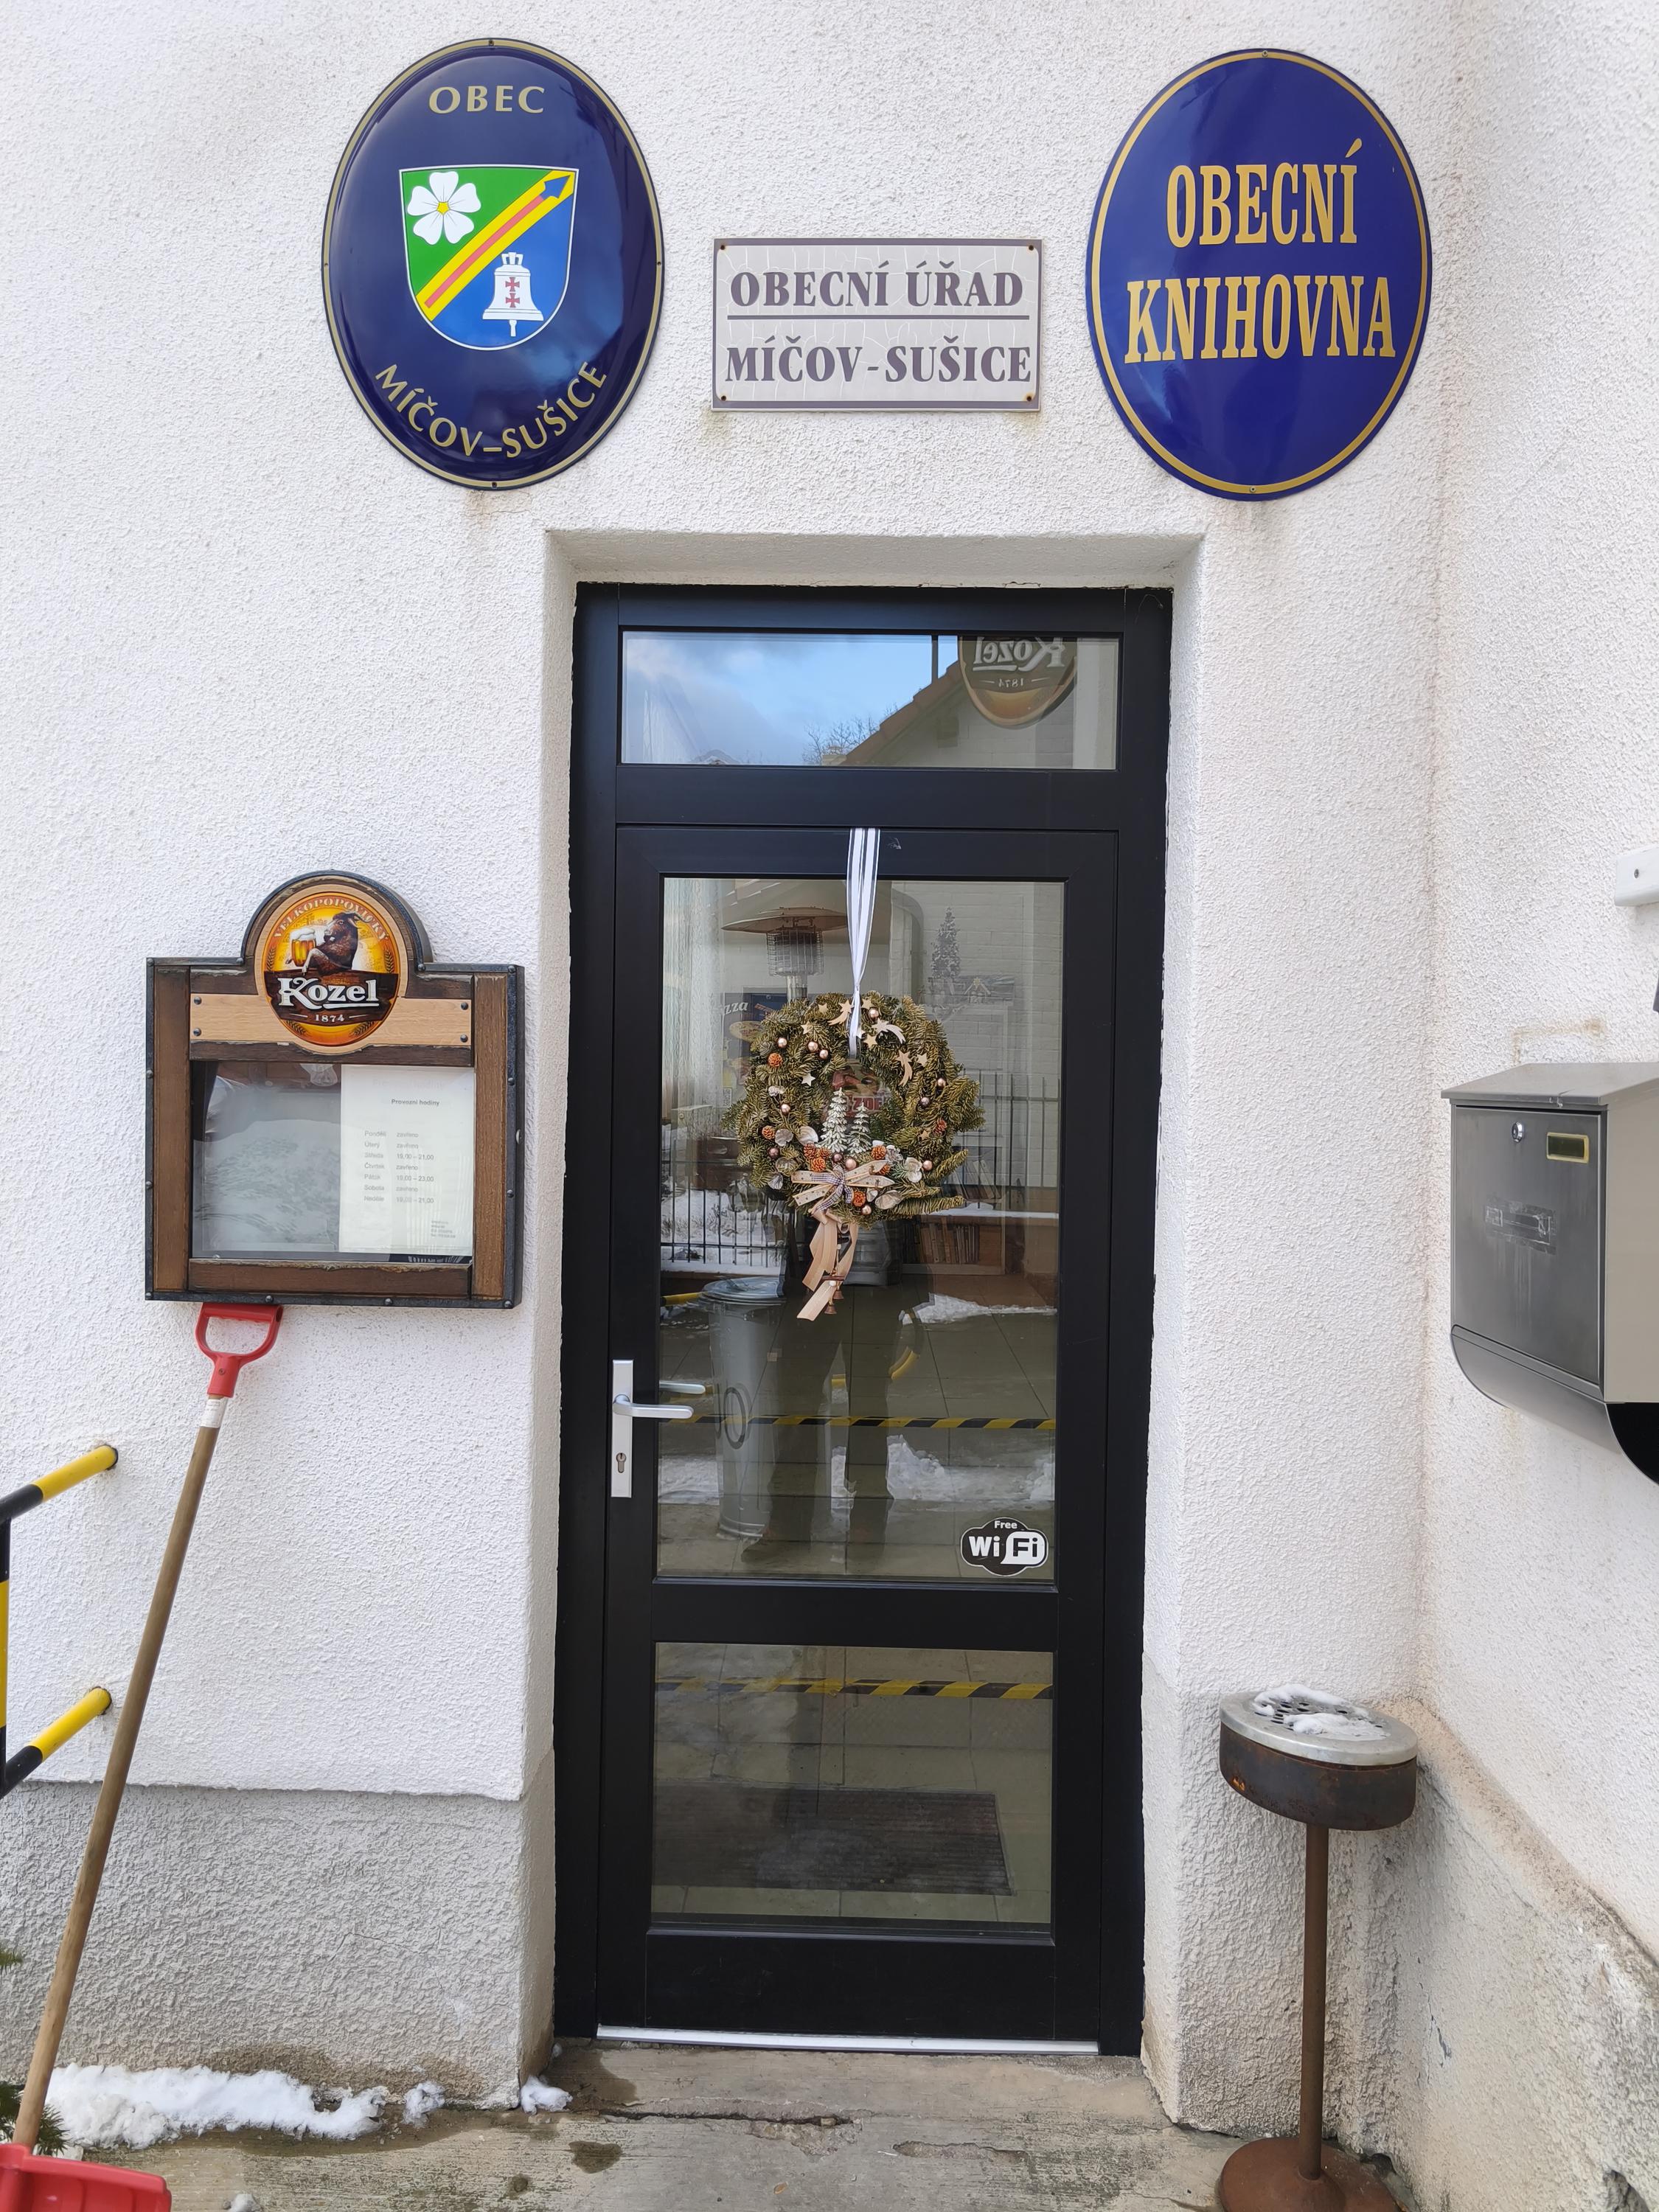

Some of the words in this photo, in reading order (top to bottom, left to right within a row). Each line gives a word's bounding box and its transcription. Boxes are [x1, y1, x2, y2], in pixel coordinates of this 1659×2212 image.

[428, 84, 546, 115] OBEC
[1166, 137, 1363, 248] OBECNÍ
[730, 260, 889, 307] OBECNÍ
[905, 260, 1023, 307] ÚŘAD
[1124, 273, 1397, 364] KNIHOVNA
[725, 335, 1032, 383] MÍČOV-SUŠICE
[277, 977, 380, 1010] Kozel
[315, 1014, 345, 1023] 1874
[994, 1520, 1018, 1529] Free
